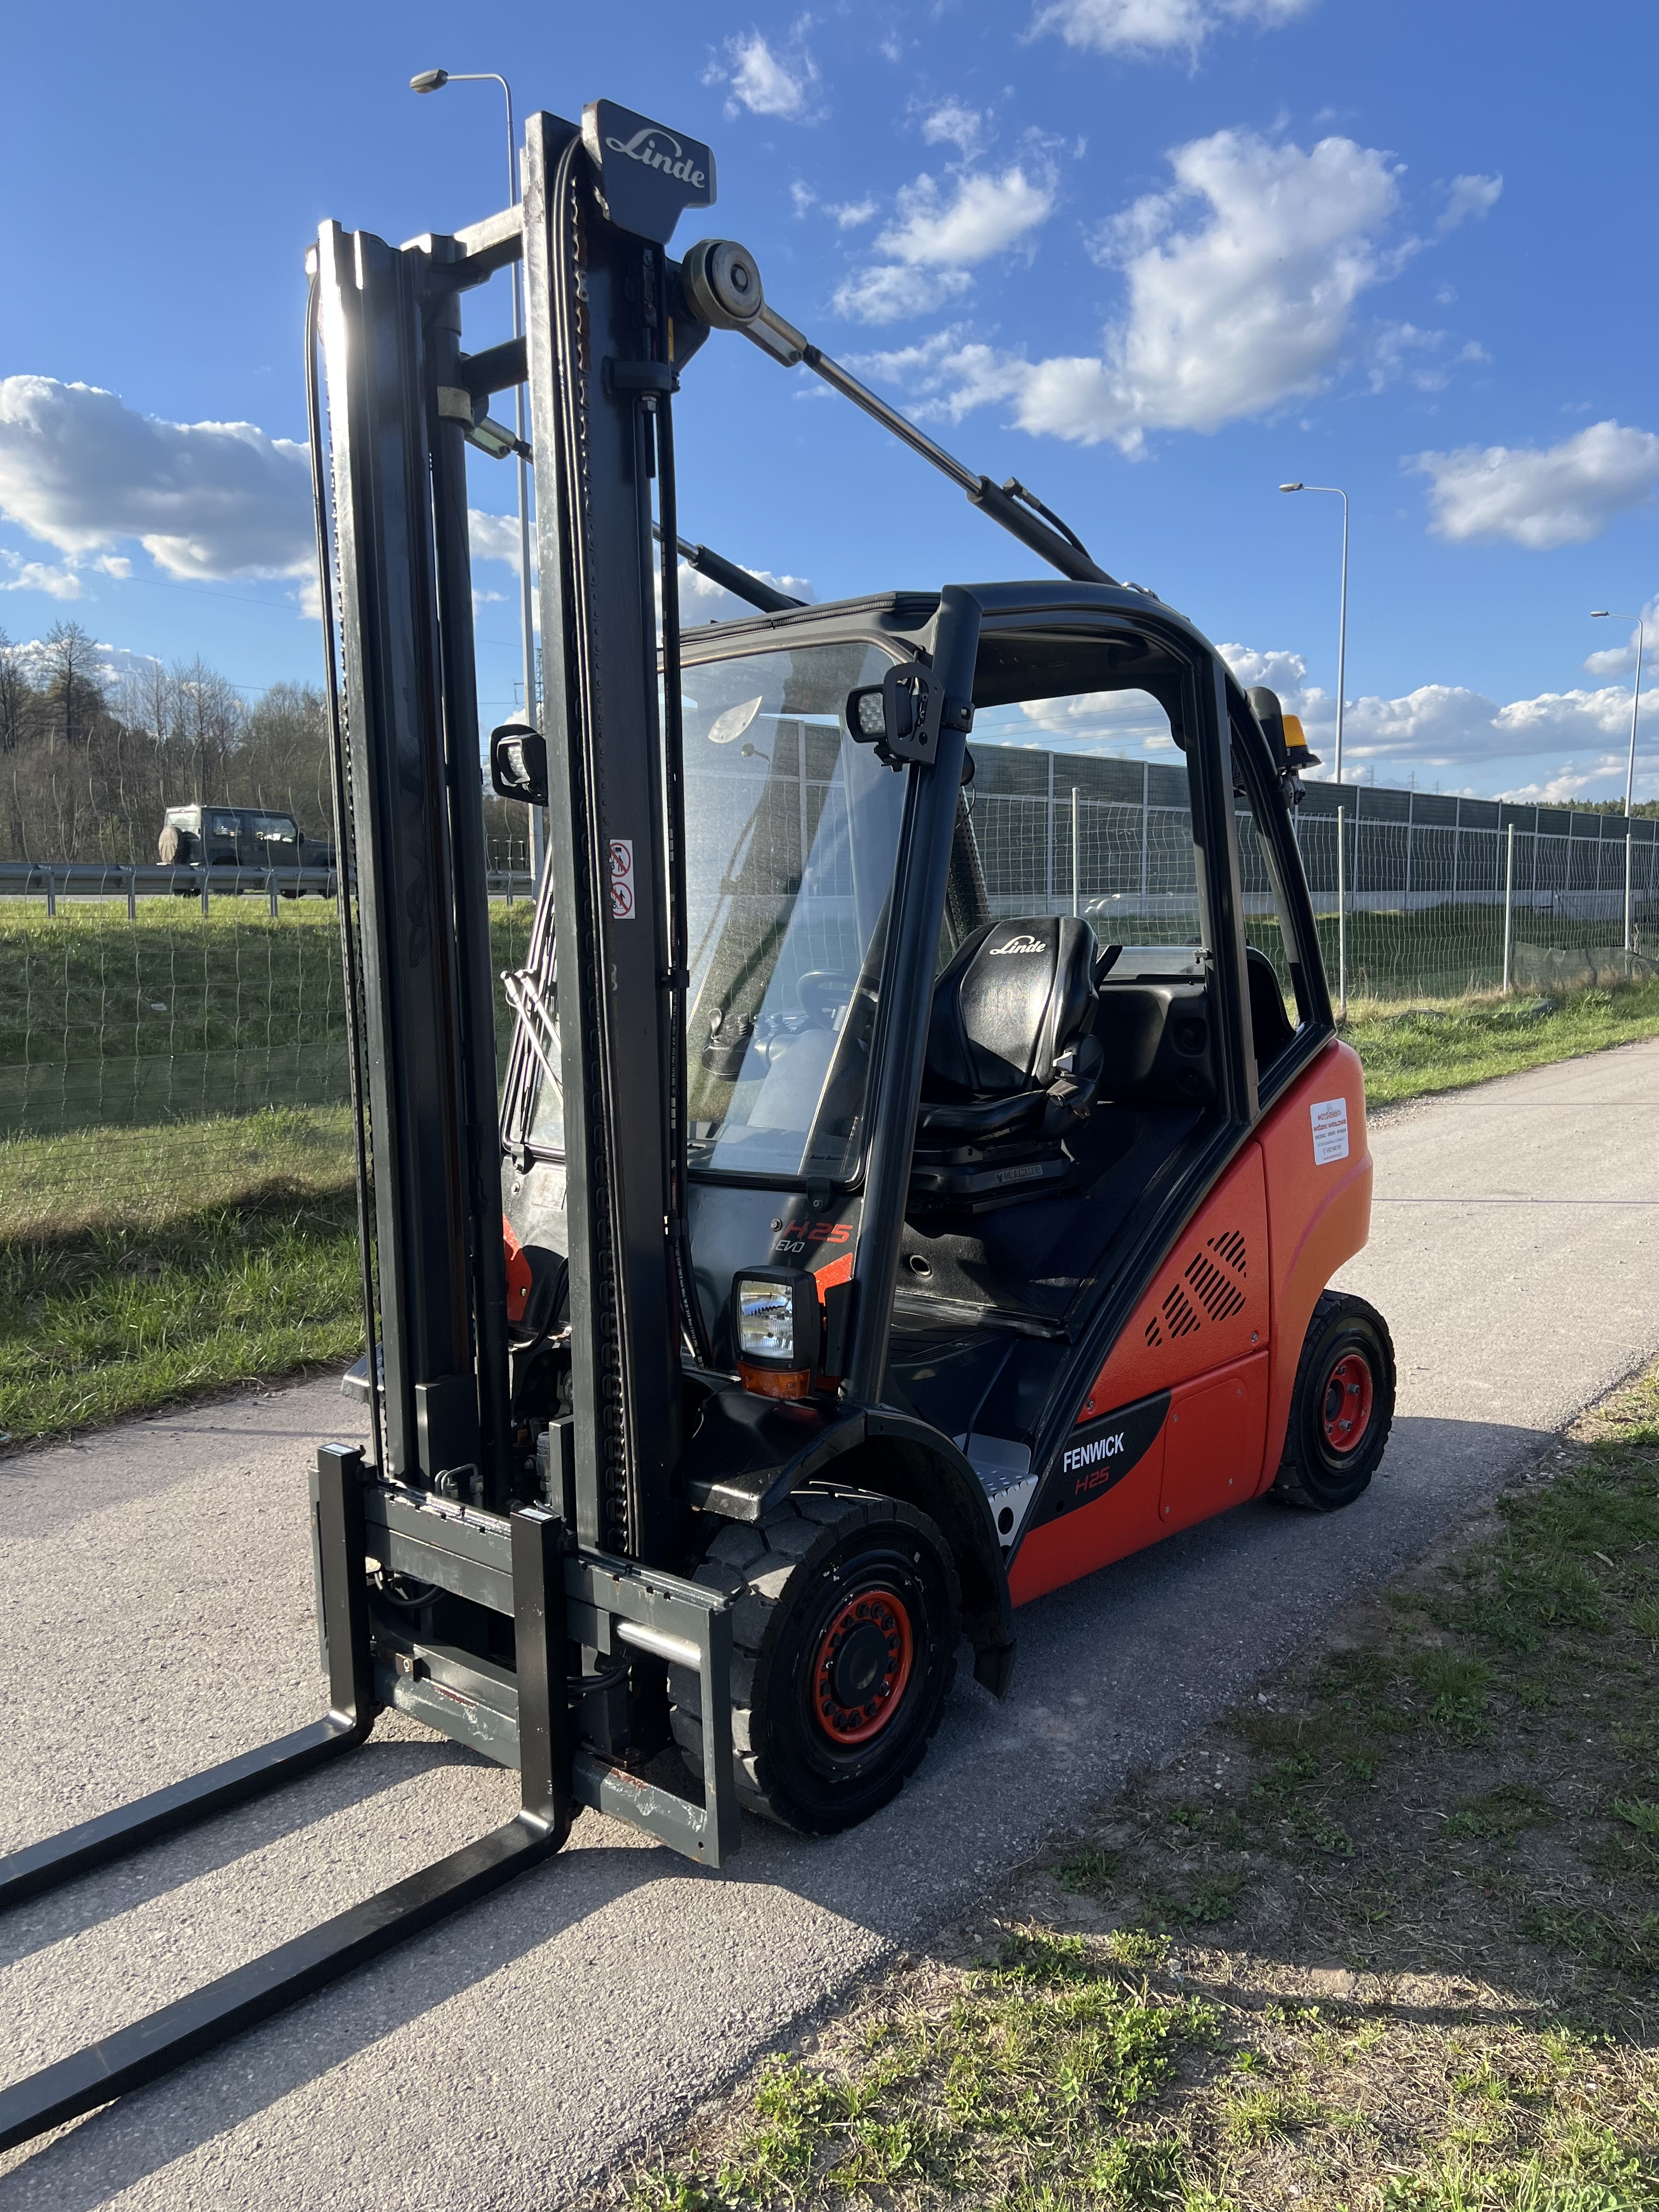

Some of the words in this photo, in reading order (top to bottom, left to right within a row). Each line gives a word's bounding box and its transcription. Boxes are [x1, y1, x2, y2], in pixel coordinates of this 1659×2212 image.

[605, 128, 705, 188] Linde
[989, 935, 1046, 955] Linde
[783, 1220, 853, 1243] H25
[775, 1240, 805, 1252] EVO
[1063, 1432, 1124, 1472] FENWICK
[1074, 1466, 1110, 1496] H25
